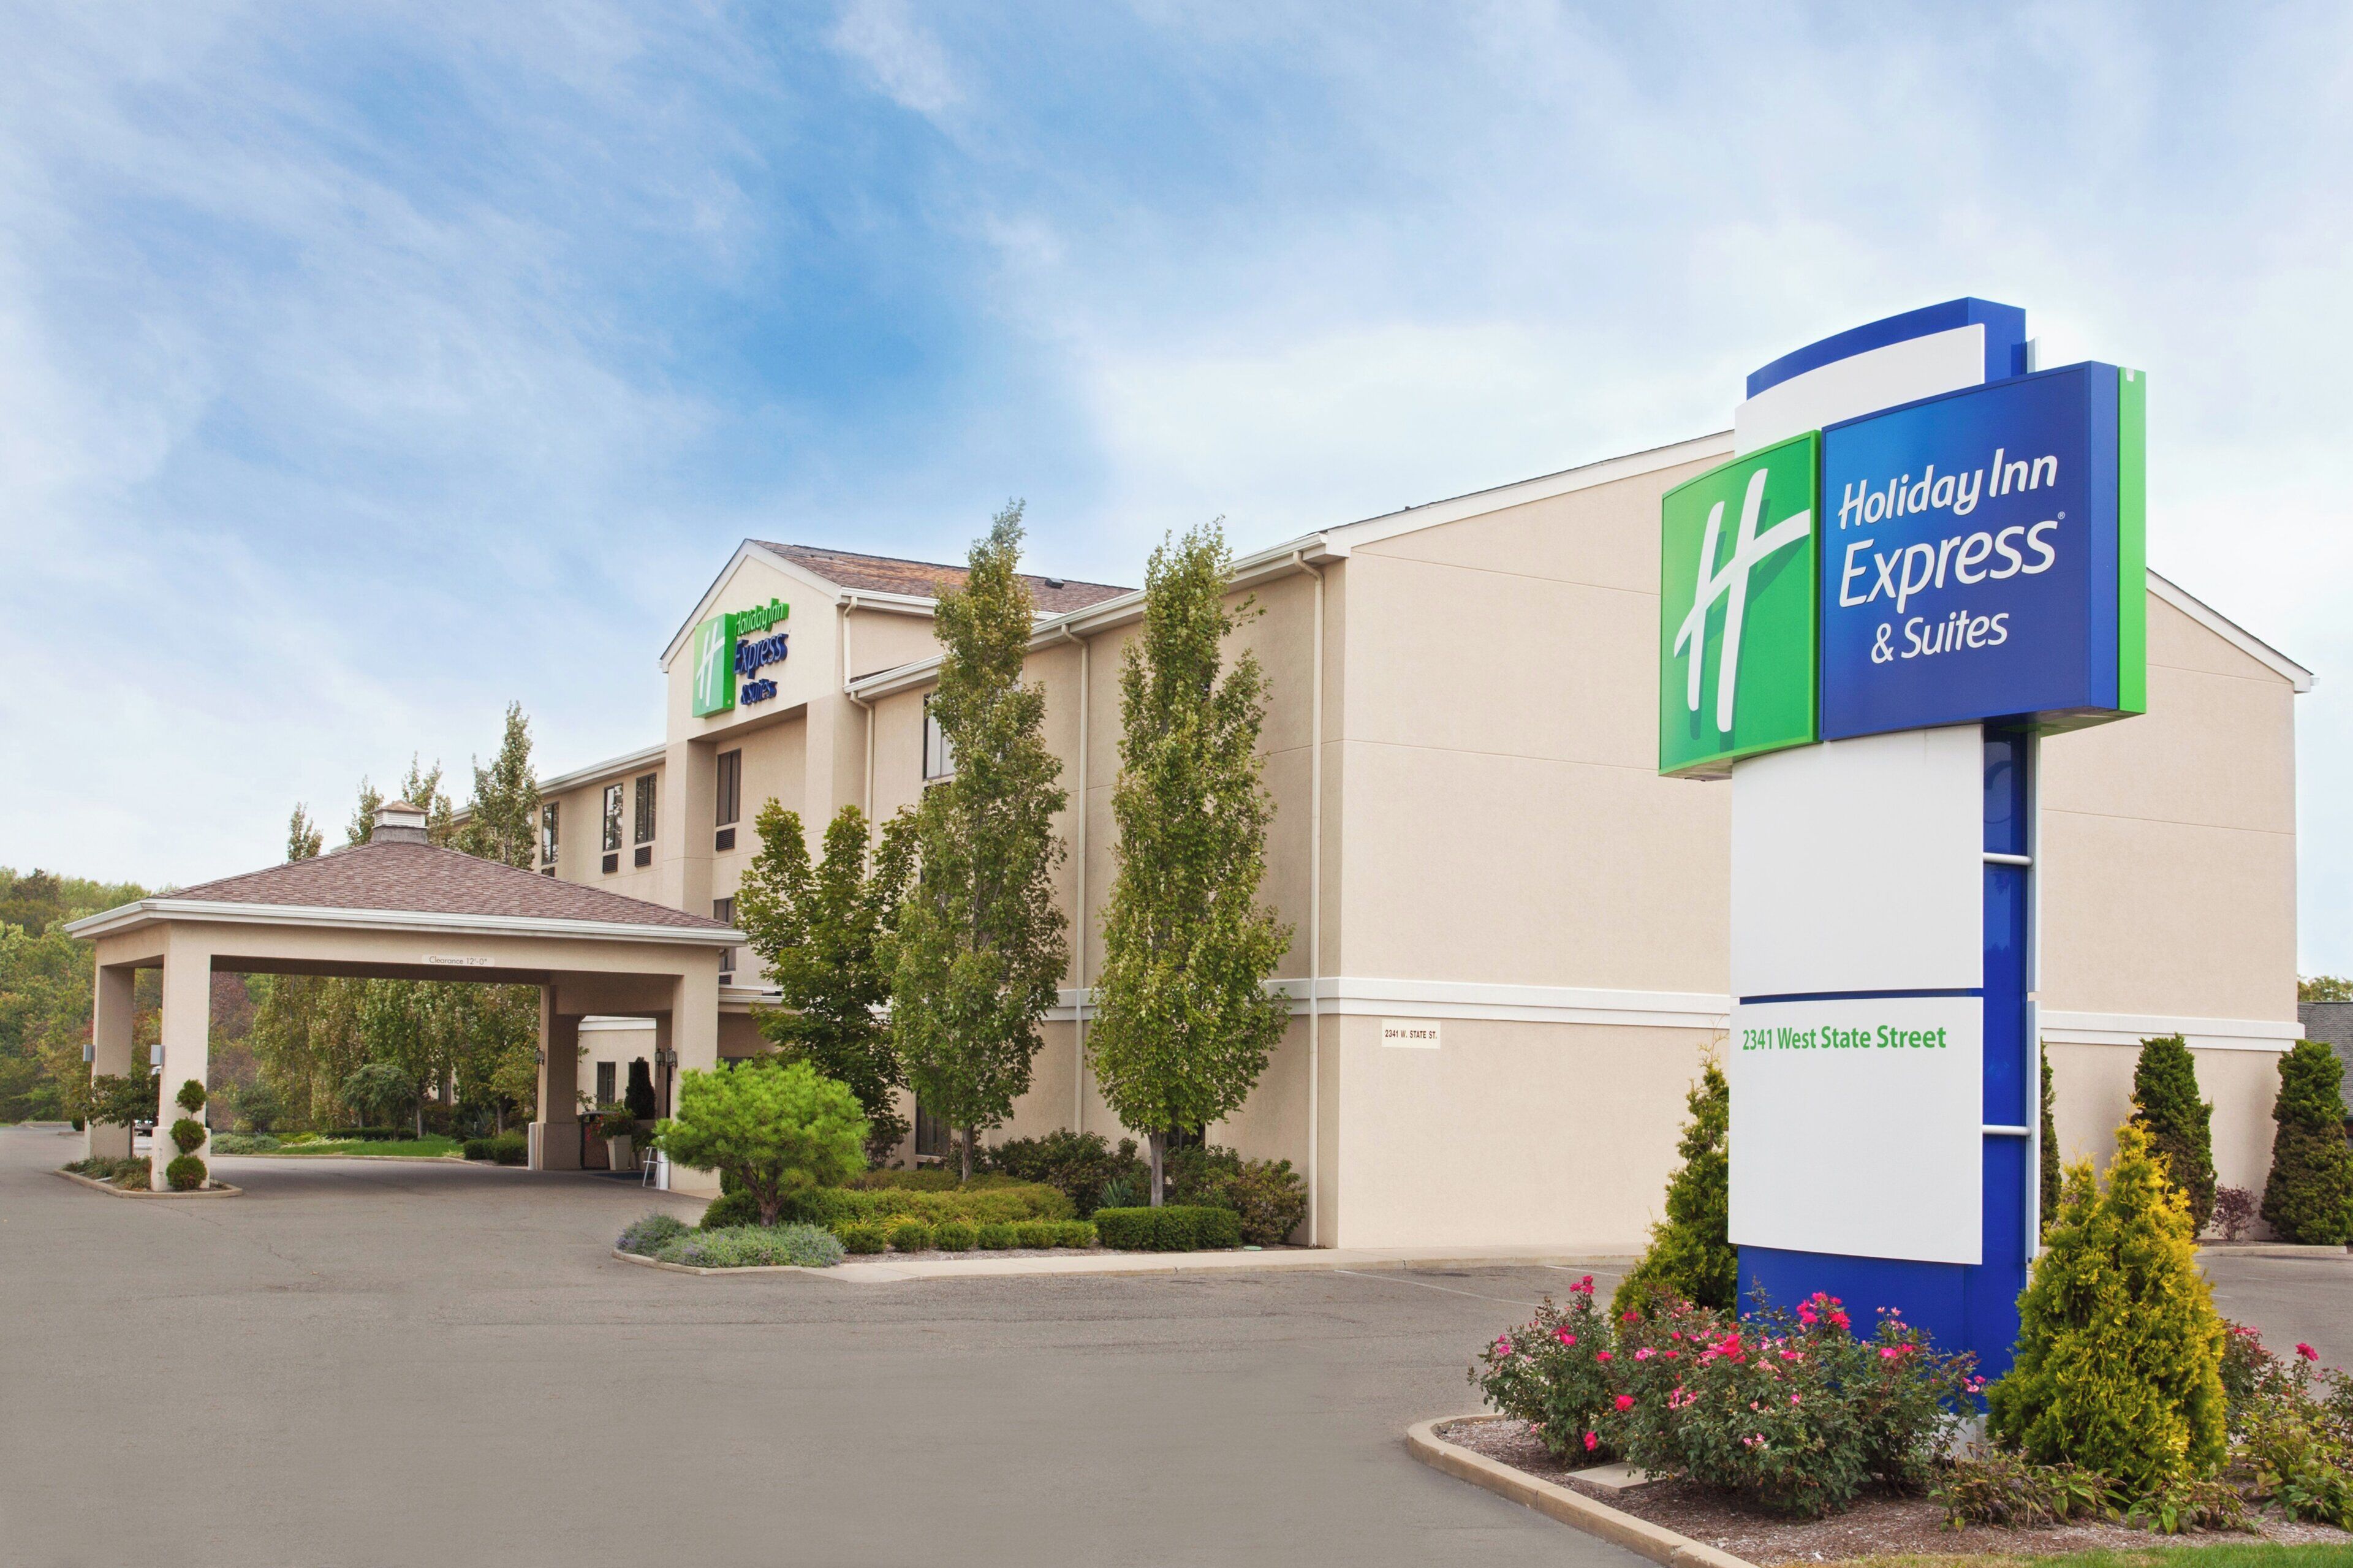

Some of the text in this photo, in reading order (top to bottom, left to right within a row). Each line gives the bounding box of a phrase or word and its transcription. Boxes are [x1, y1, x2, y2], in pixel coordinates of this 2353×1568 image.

[1838, 447, 2058, 531] Holiday Inn
[1839, 520, 2058, 615] Express
[769, 598, 787, 623] Inn
[1871, 610, 2010, 664] & Suites
[734, 633, 787, 679] Express
[749, 680, 776, 703] Suites
[429, 955, 488, 966] Clearance 12'-0"
[1409, 1030, 1427, 1039] STATE
[1743, 1024, 1947, 1051] 2341 West State Street
